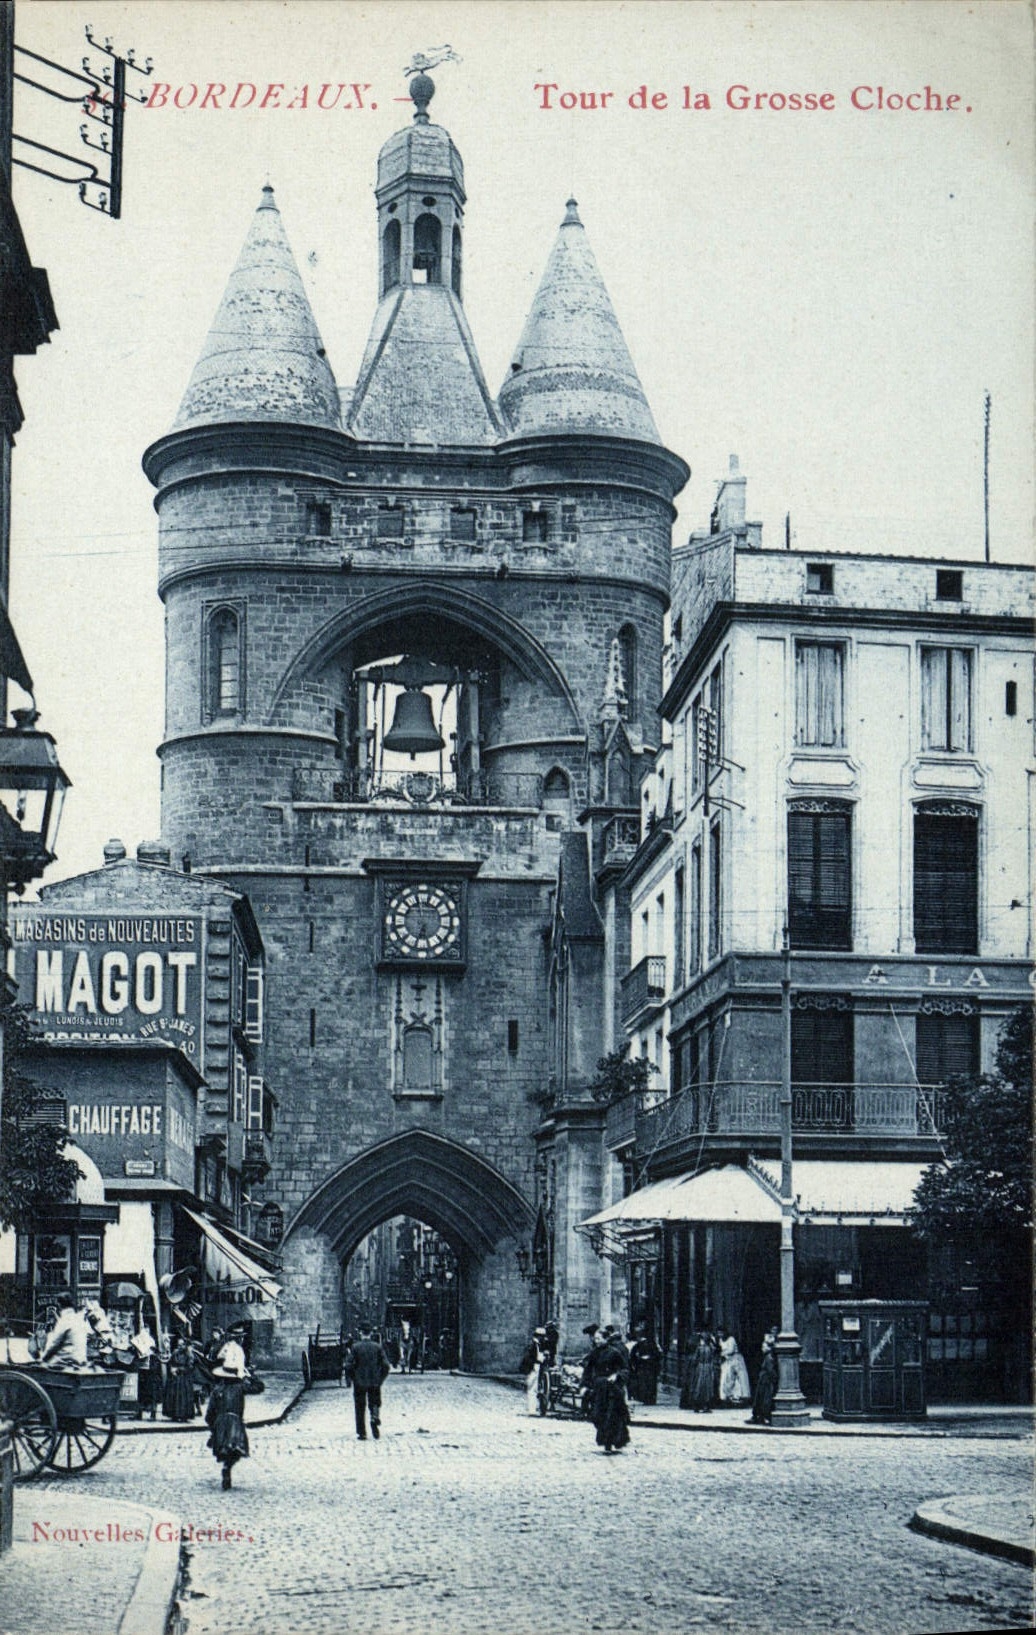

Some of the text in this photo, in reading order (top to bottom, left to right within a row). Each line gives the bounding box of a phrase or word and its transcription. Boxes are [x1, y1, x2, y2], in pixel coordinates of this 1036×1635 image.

[15, 919, 86, 941] MAGASINS
[89, 922, 105, 941] de
[36, 950, 197, 1015] MAGOT
[862, 963, 888, 985] A
[139, 1020, 159, 1038] RUE
[67, 1105, 163, 1135] CHAUFFAGE
